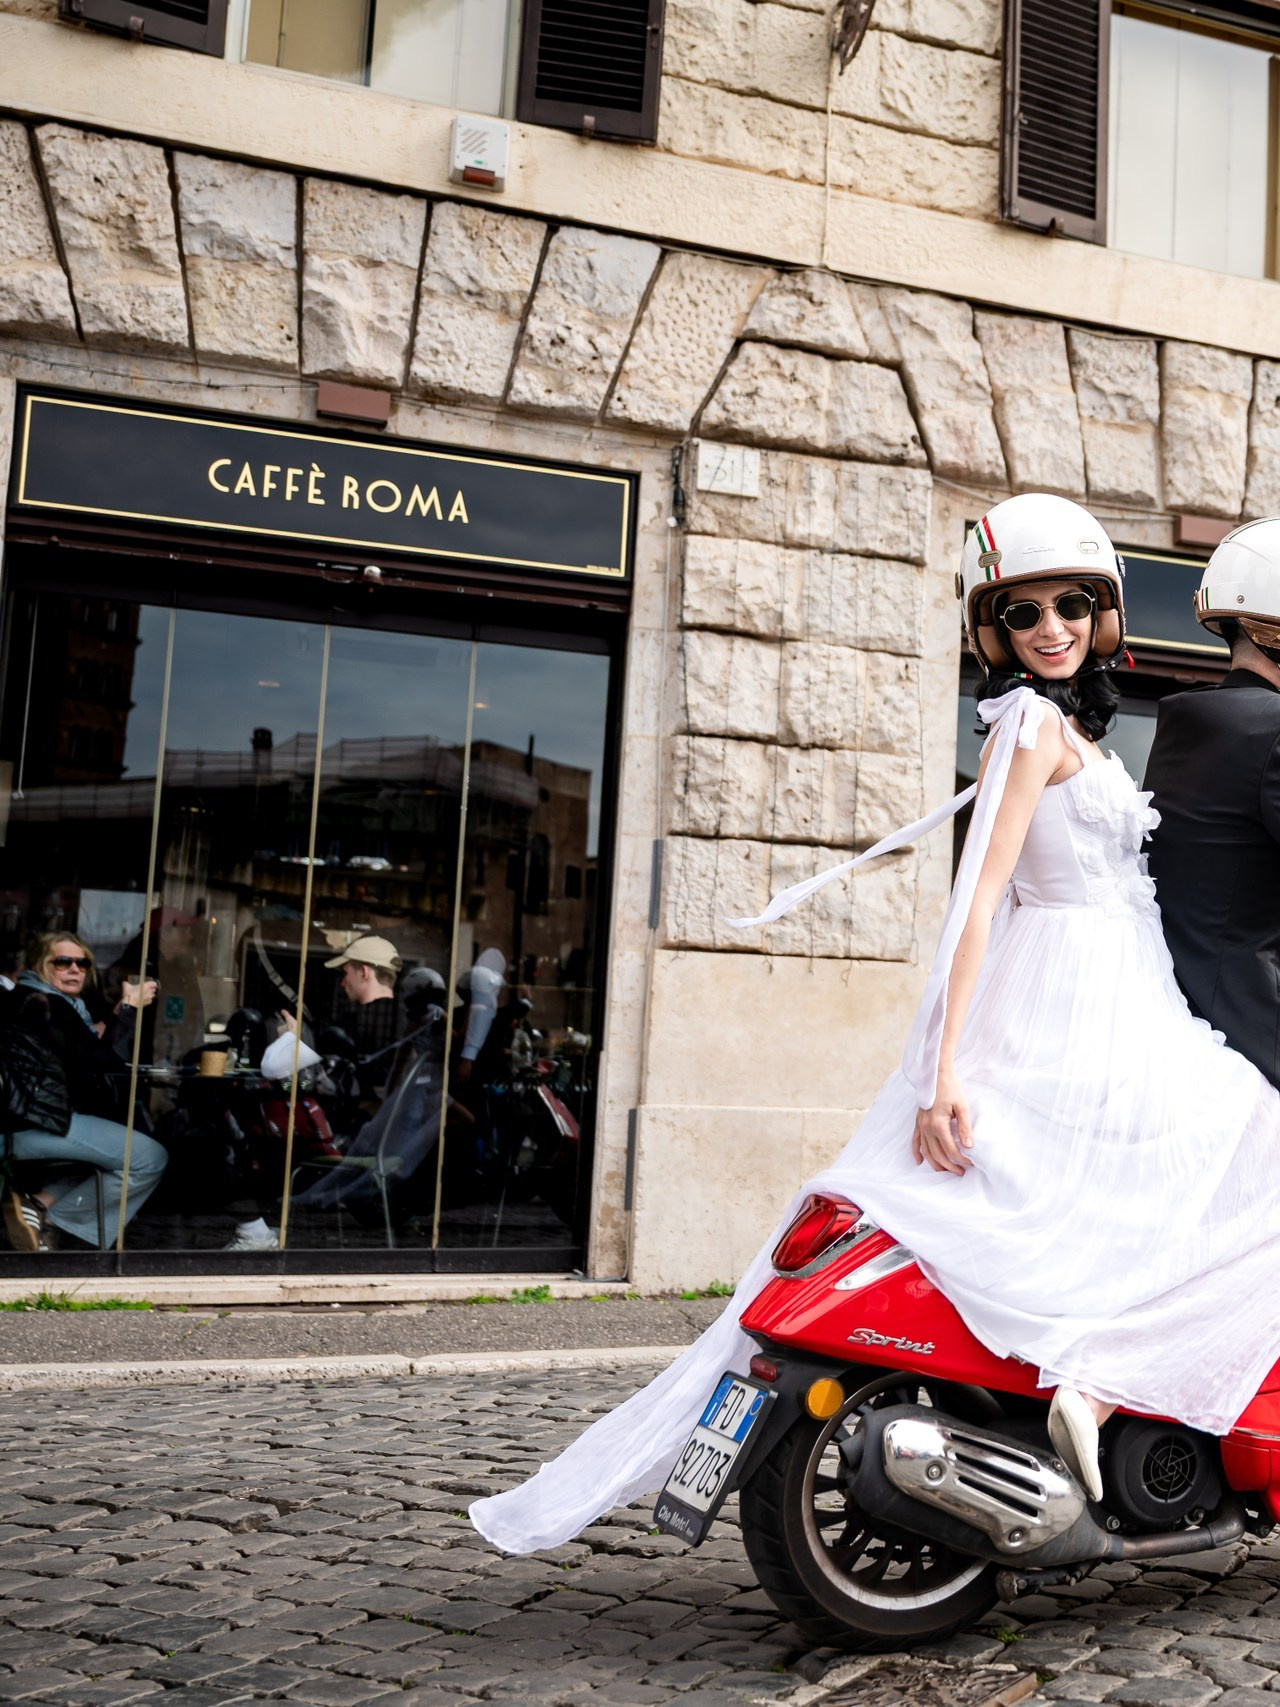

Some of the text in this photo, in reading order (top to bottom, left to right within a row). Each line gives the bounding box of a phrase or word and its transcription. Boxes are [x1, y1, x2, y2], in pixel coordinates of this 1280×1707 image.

[208, 458, 469, 524] CAFFÈ ROMA
[847, 1328, 936, 1355] Sprint
[711, 1384, 746, 1430] FD
[674, 1438, 732, 1499] 92703
